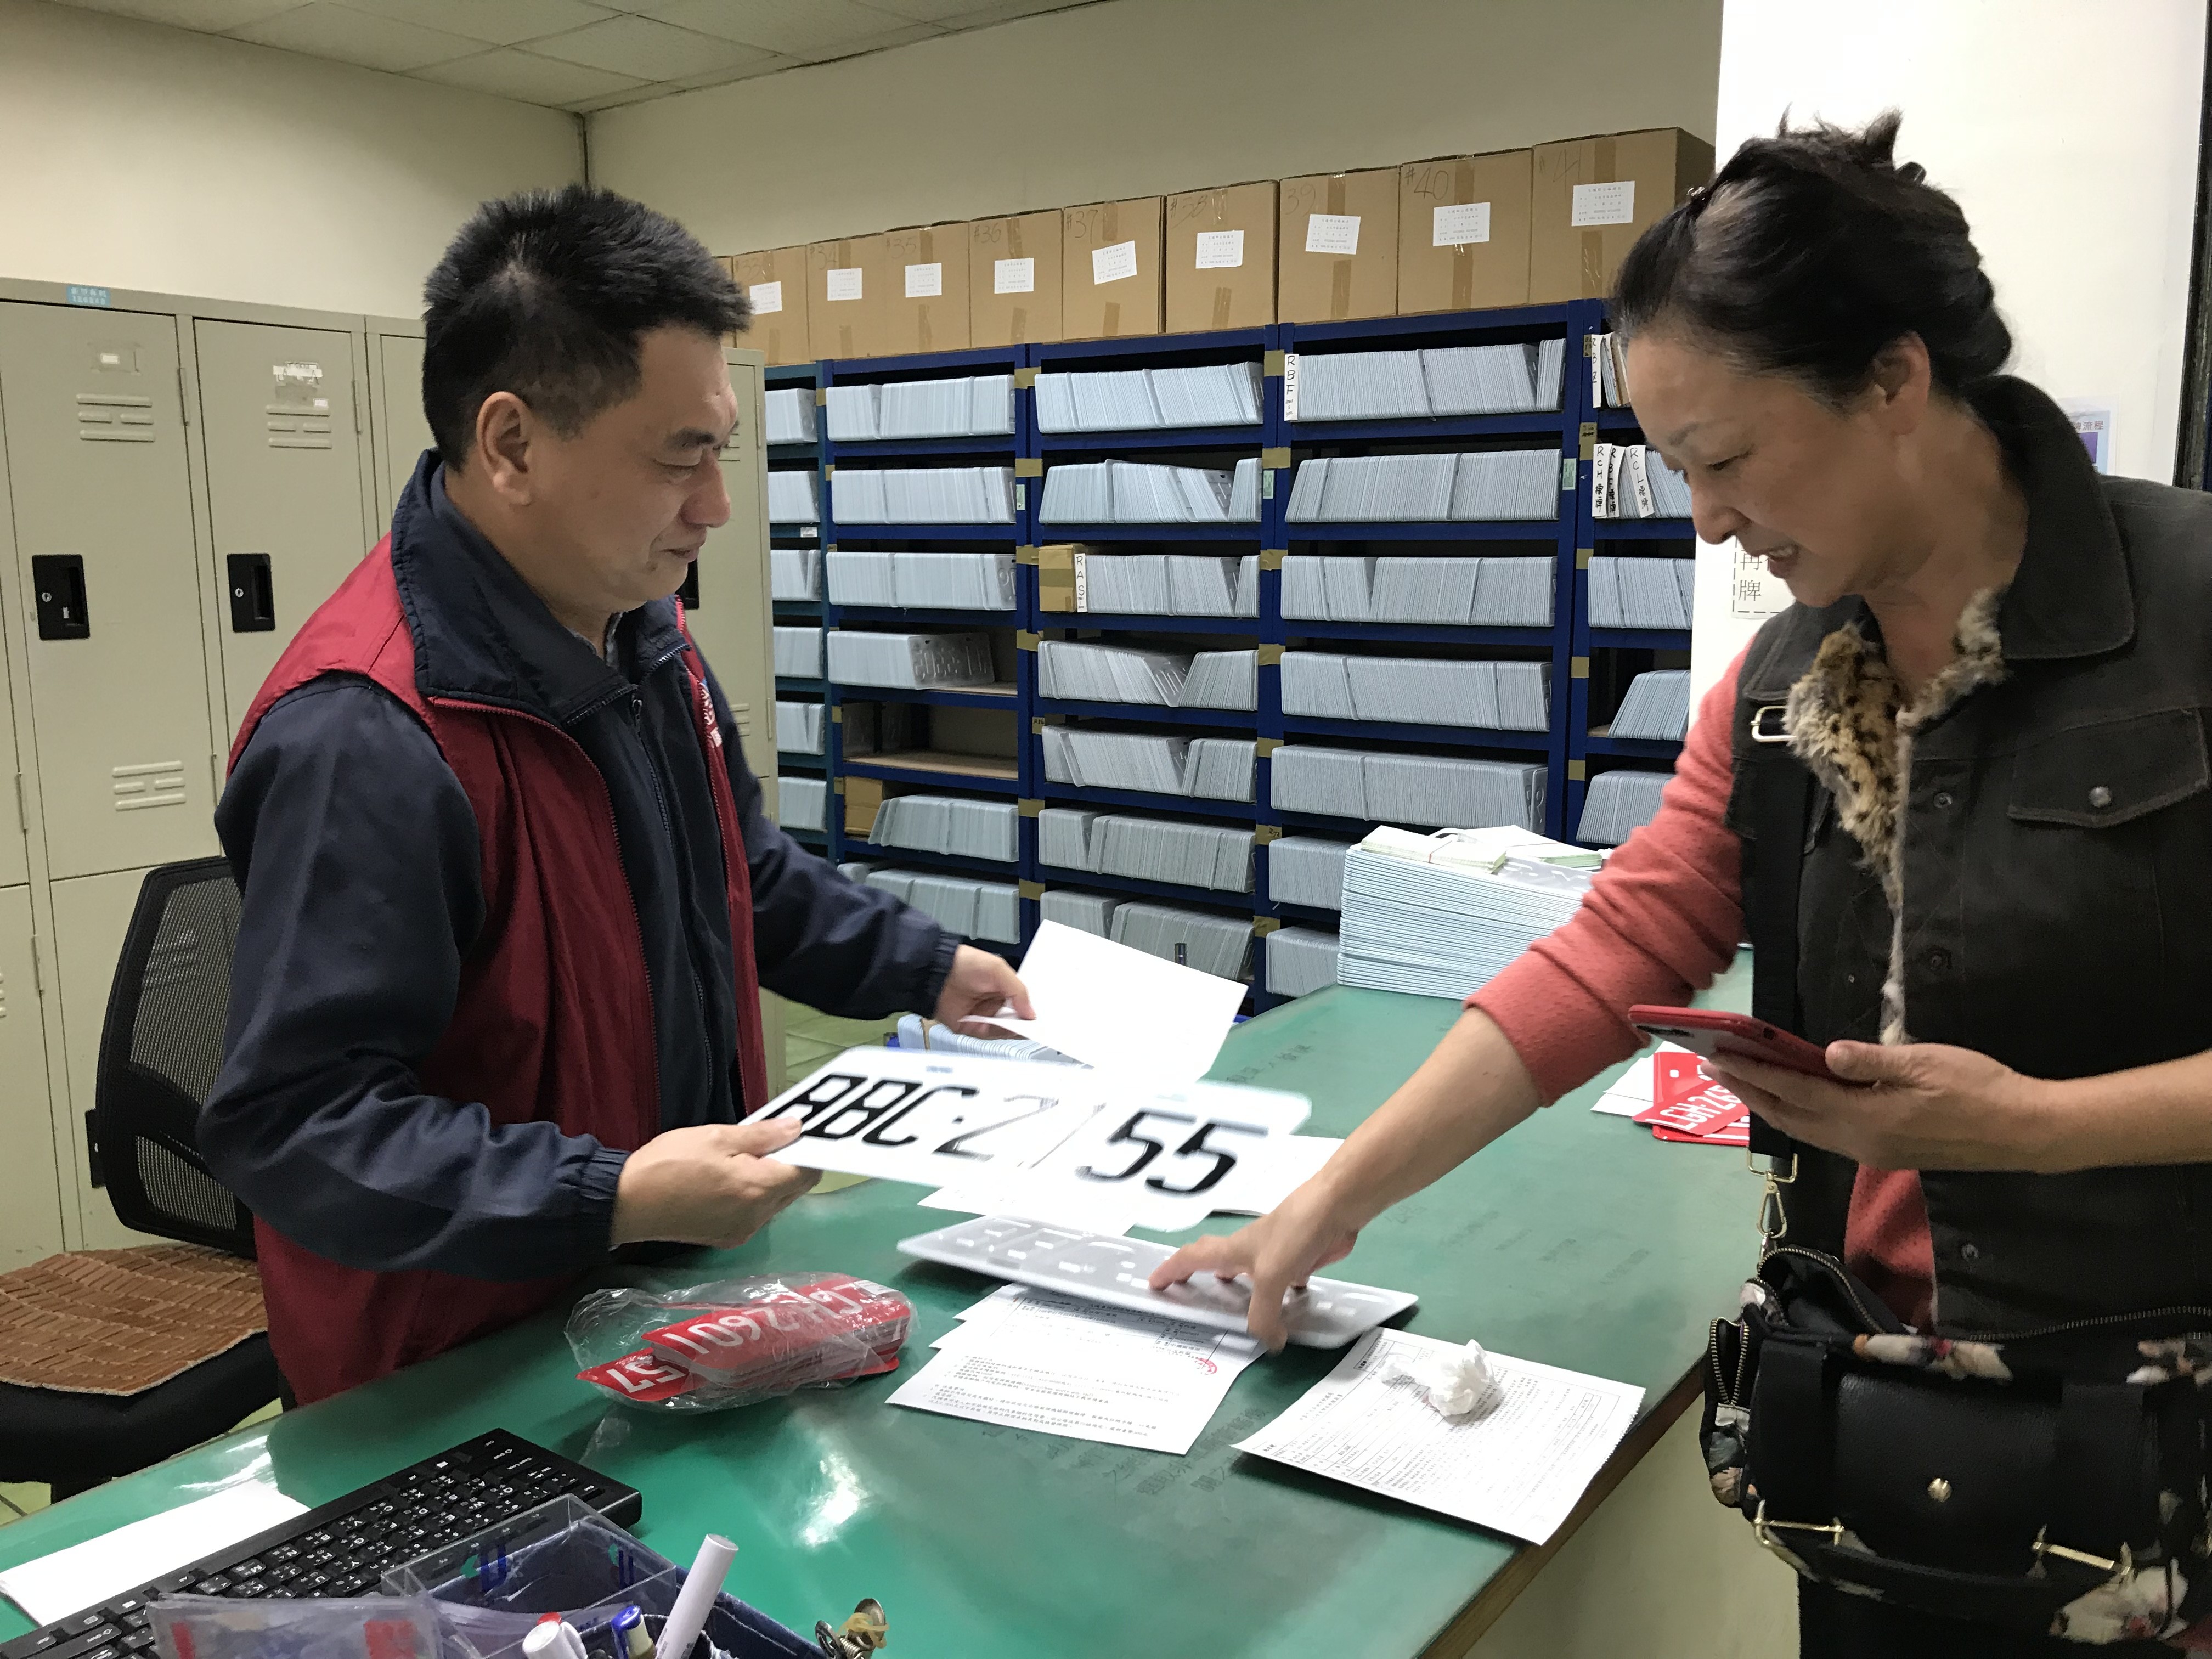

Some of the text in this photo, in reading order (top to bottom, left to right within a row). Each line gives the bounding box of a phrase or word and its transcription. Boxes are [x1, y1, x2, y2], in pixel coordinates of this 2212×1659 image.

[1066, 210, 1098, 244] #37
[1076, 556, 1085, 596] RAS
[1738, 580, 1762, 601] 牌
